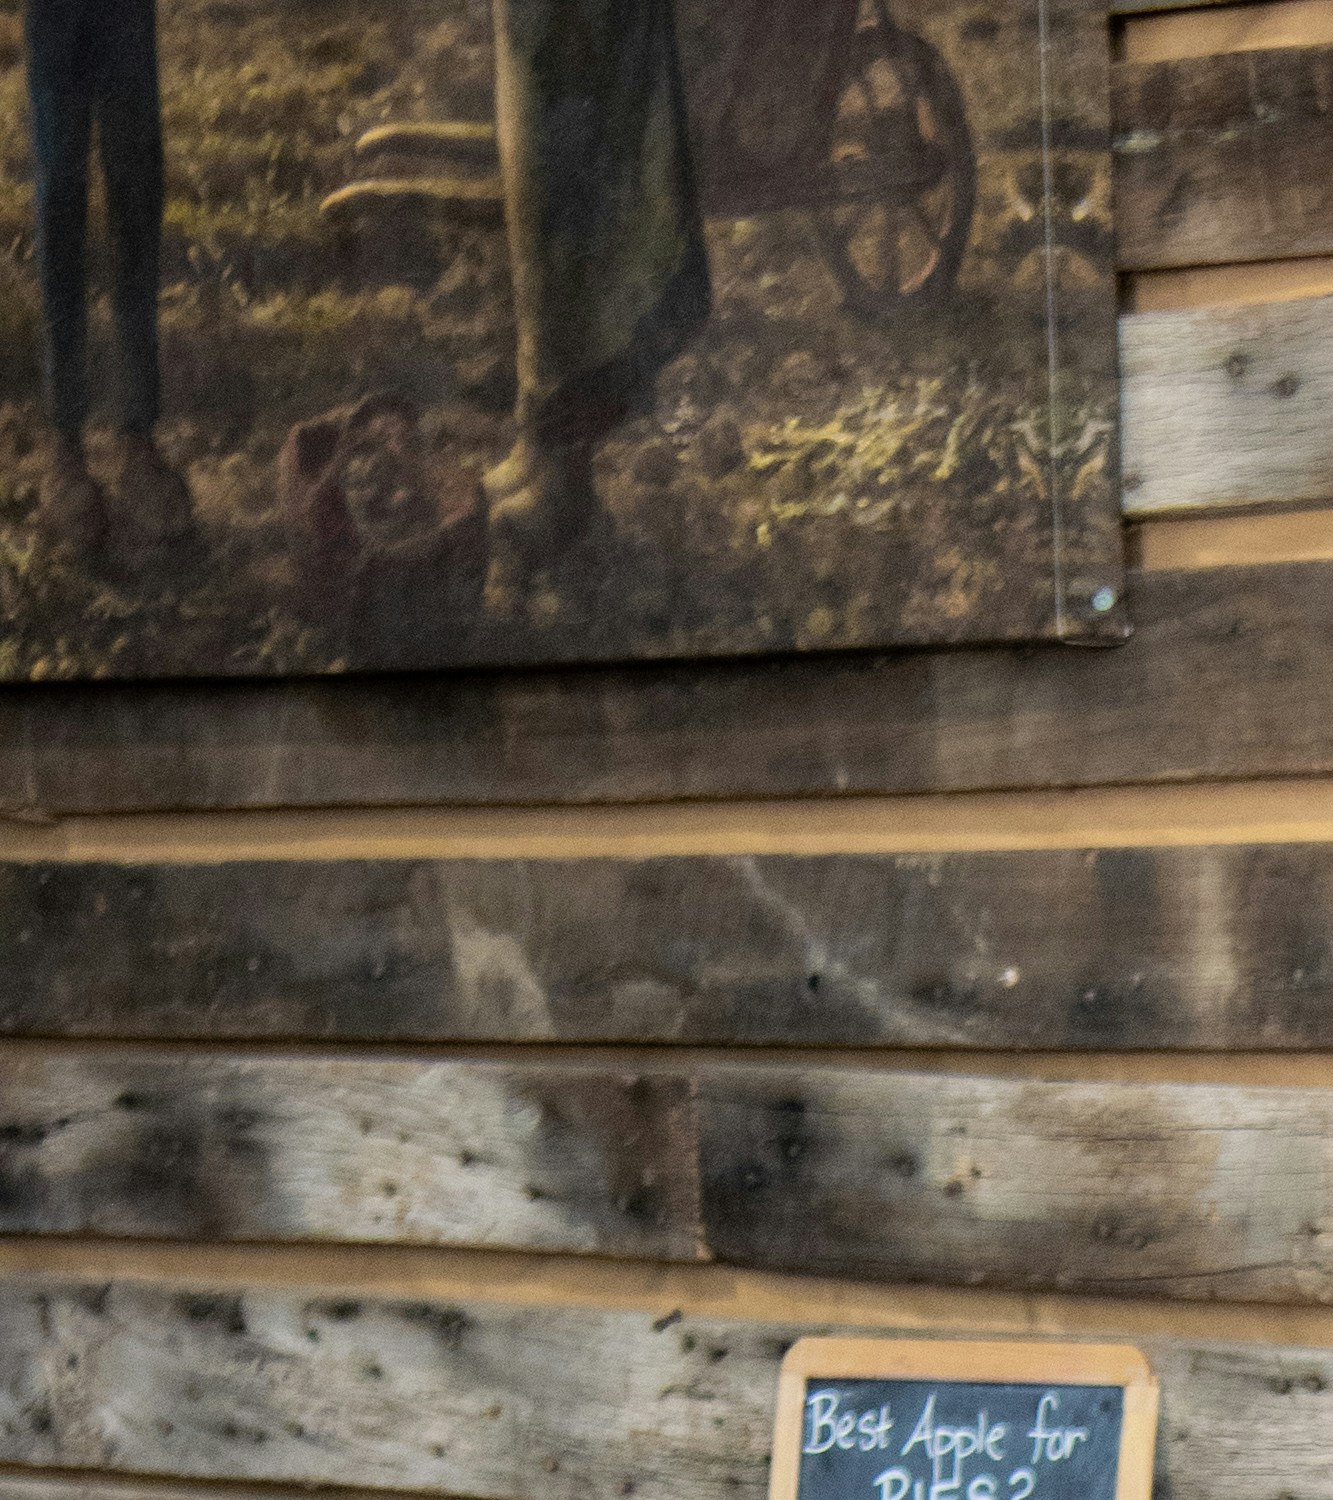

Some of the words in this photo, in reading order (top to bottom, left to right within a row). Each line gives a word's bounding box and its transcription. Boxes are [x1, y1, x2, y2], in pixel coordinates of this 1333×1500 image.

[803, 1388, 894, 1455] Best
[901, 1391, 1008, 1485] Apple
[1027, 1389, 1089, 1465] for
